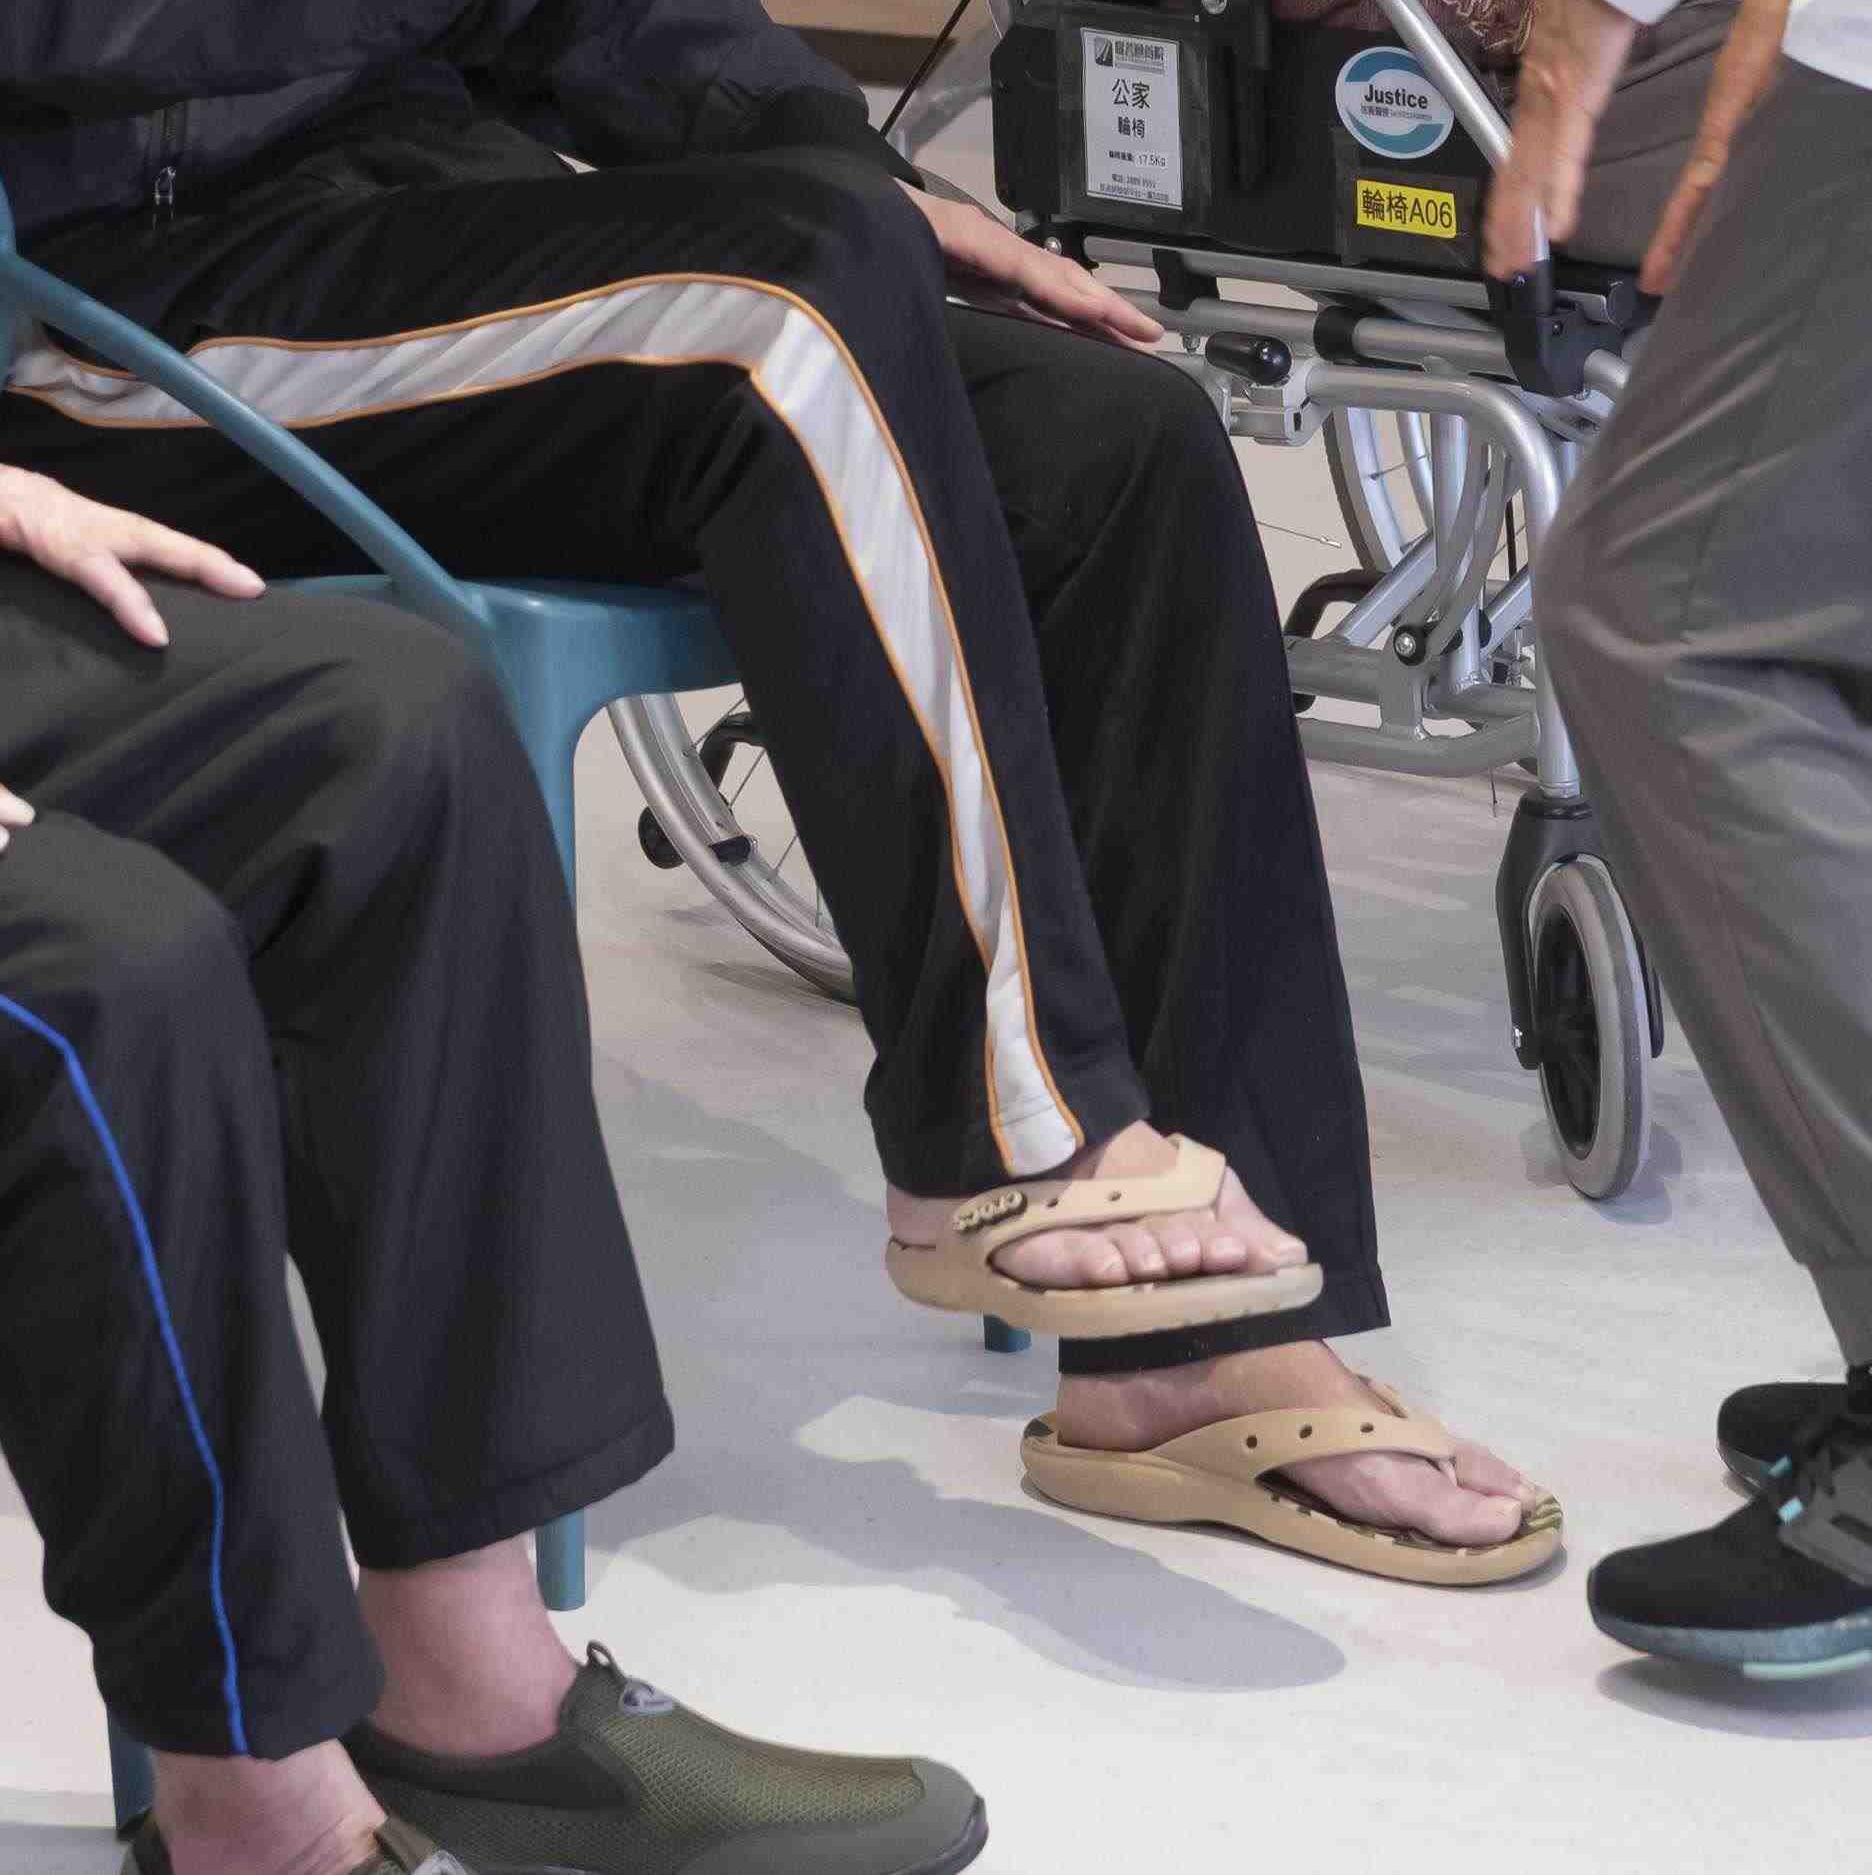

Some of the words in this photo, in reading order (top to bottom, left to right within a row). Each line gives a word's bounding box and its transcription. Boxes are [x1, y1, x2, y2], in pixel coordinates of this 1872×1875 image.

[1111, 77, 1151, 109] 公家
[1364, 83, 1428, 110] Justice
[1117, 116, 1146, 139] 輪椅
[1359, 186, 1453, 229] 輪椅A06
